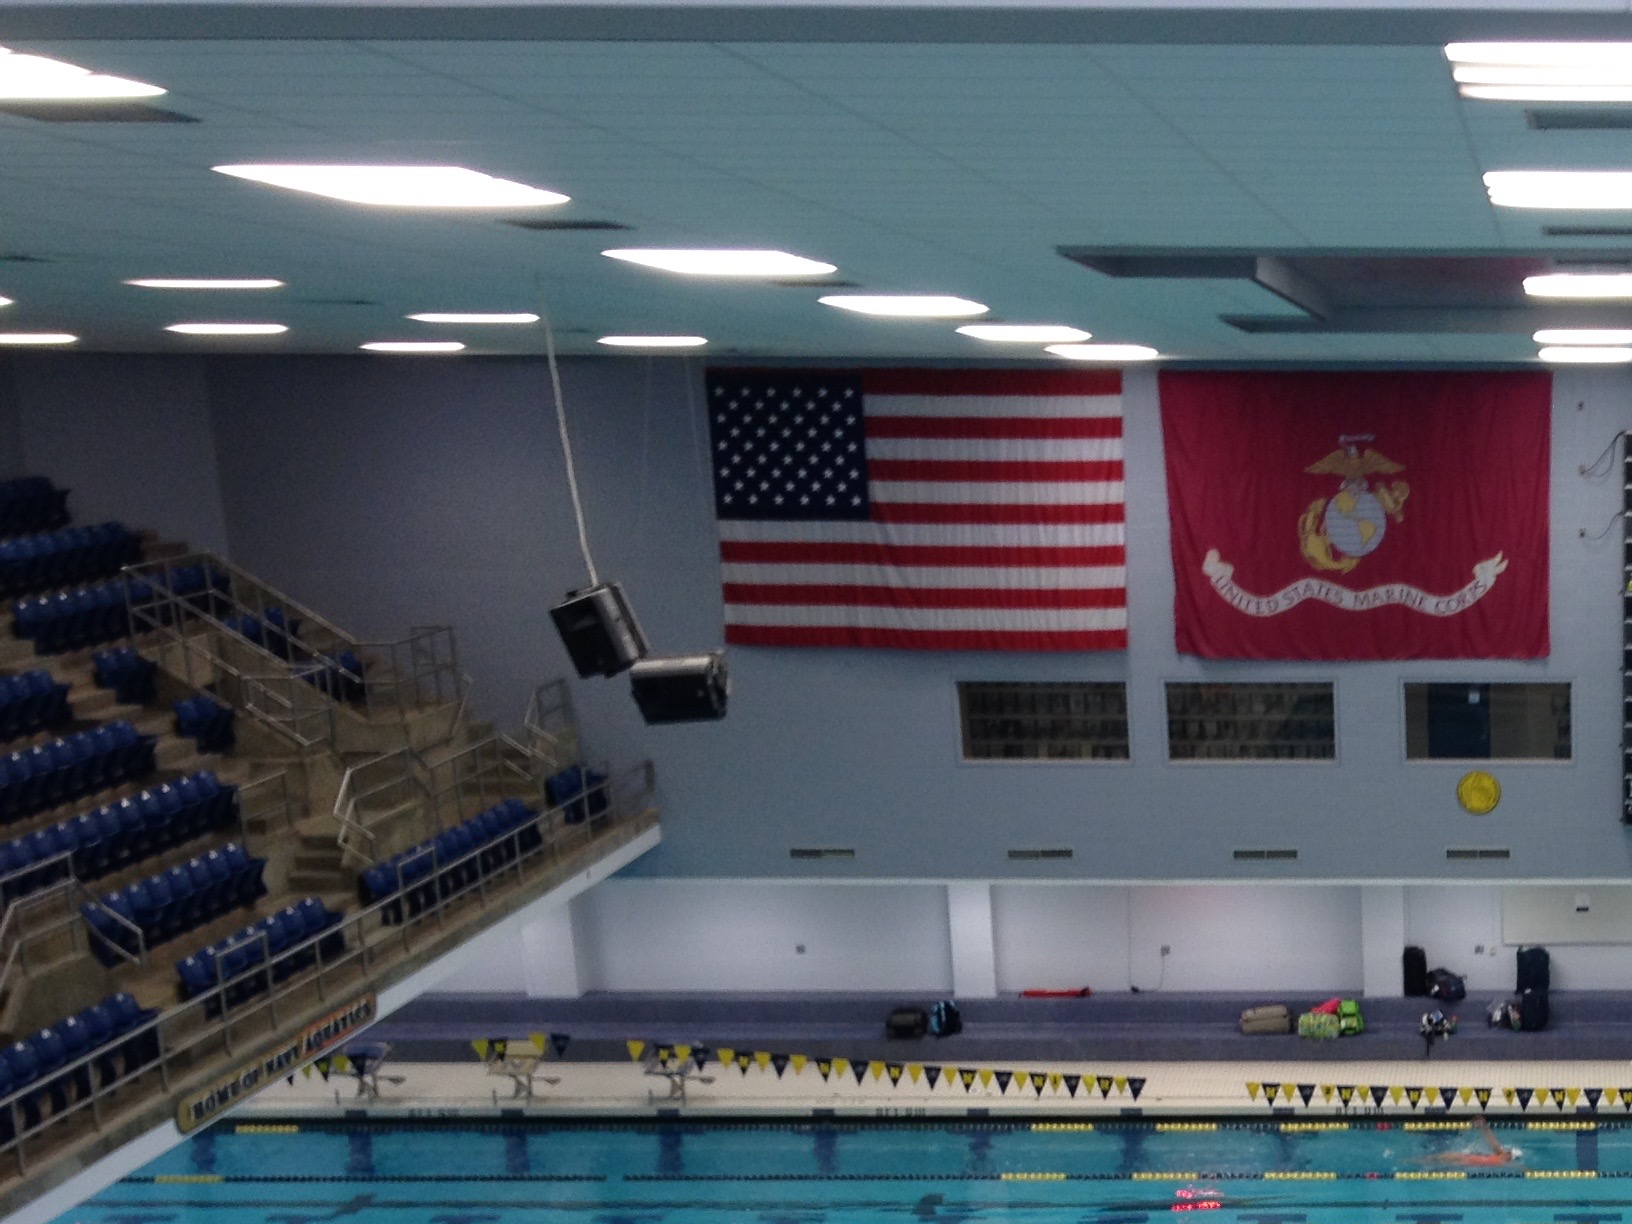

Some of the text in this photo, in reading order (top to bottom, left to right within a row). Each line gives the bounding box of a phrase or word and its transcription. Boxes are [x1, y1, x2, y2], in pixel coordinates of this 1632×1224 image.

[1215, 574, 1488, 614] UNITED STATES MARINE CORPS
